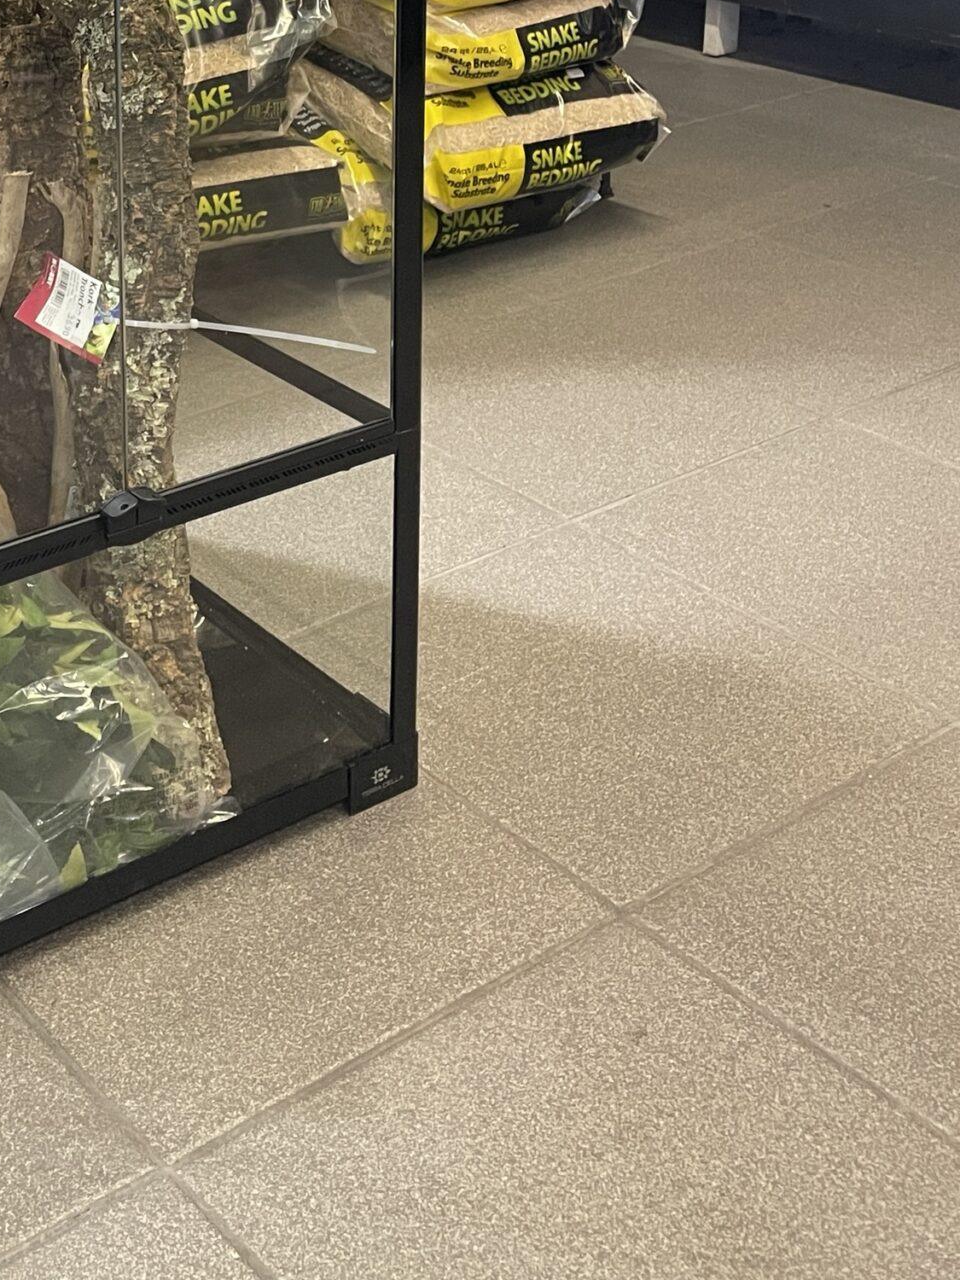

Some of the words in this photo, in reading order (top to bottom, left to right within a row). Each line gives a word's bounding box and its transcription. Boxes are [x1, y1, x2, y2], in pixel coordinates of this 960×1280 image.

[176, 1, 238, 36] DING
[526, 21, 581, 53] SNAKE
[529, 38, 599, 72] BEDDING
[449, 65, 500, 79] Substrate
[188, 84, 234, 115] AKE
[497, 74, 582, 106] BEDDING
[532, 140, 584, 171] SNAKE
[526, 158, 603, 190] BEDDING
[197, 190, 244, 218] AKE
[441, 205, 505, 234] SNAKE
[197, 210, 269, 241] DDING
